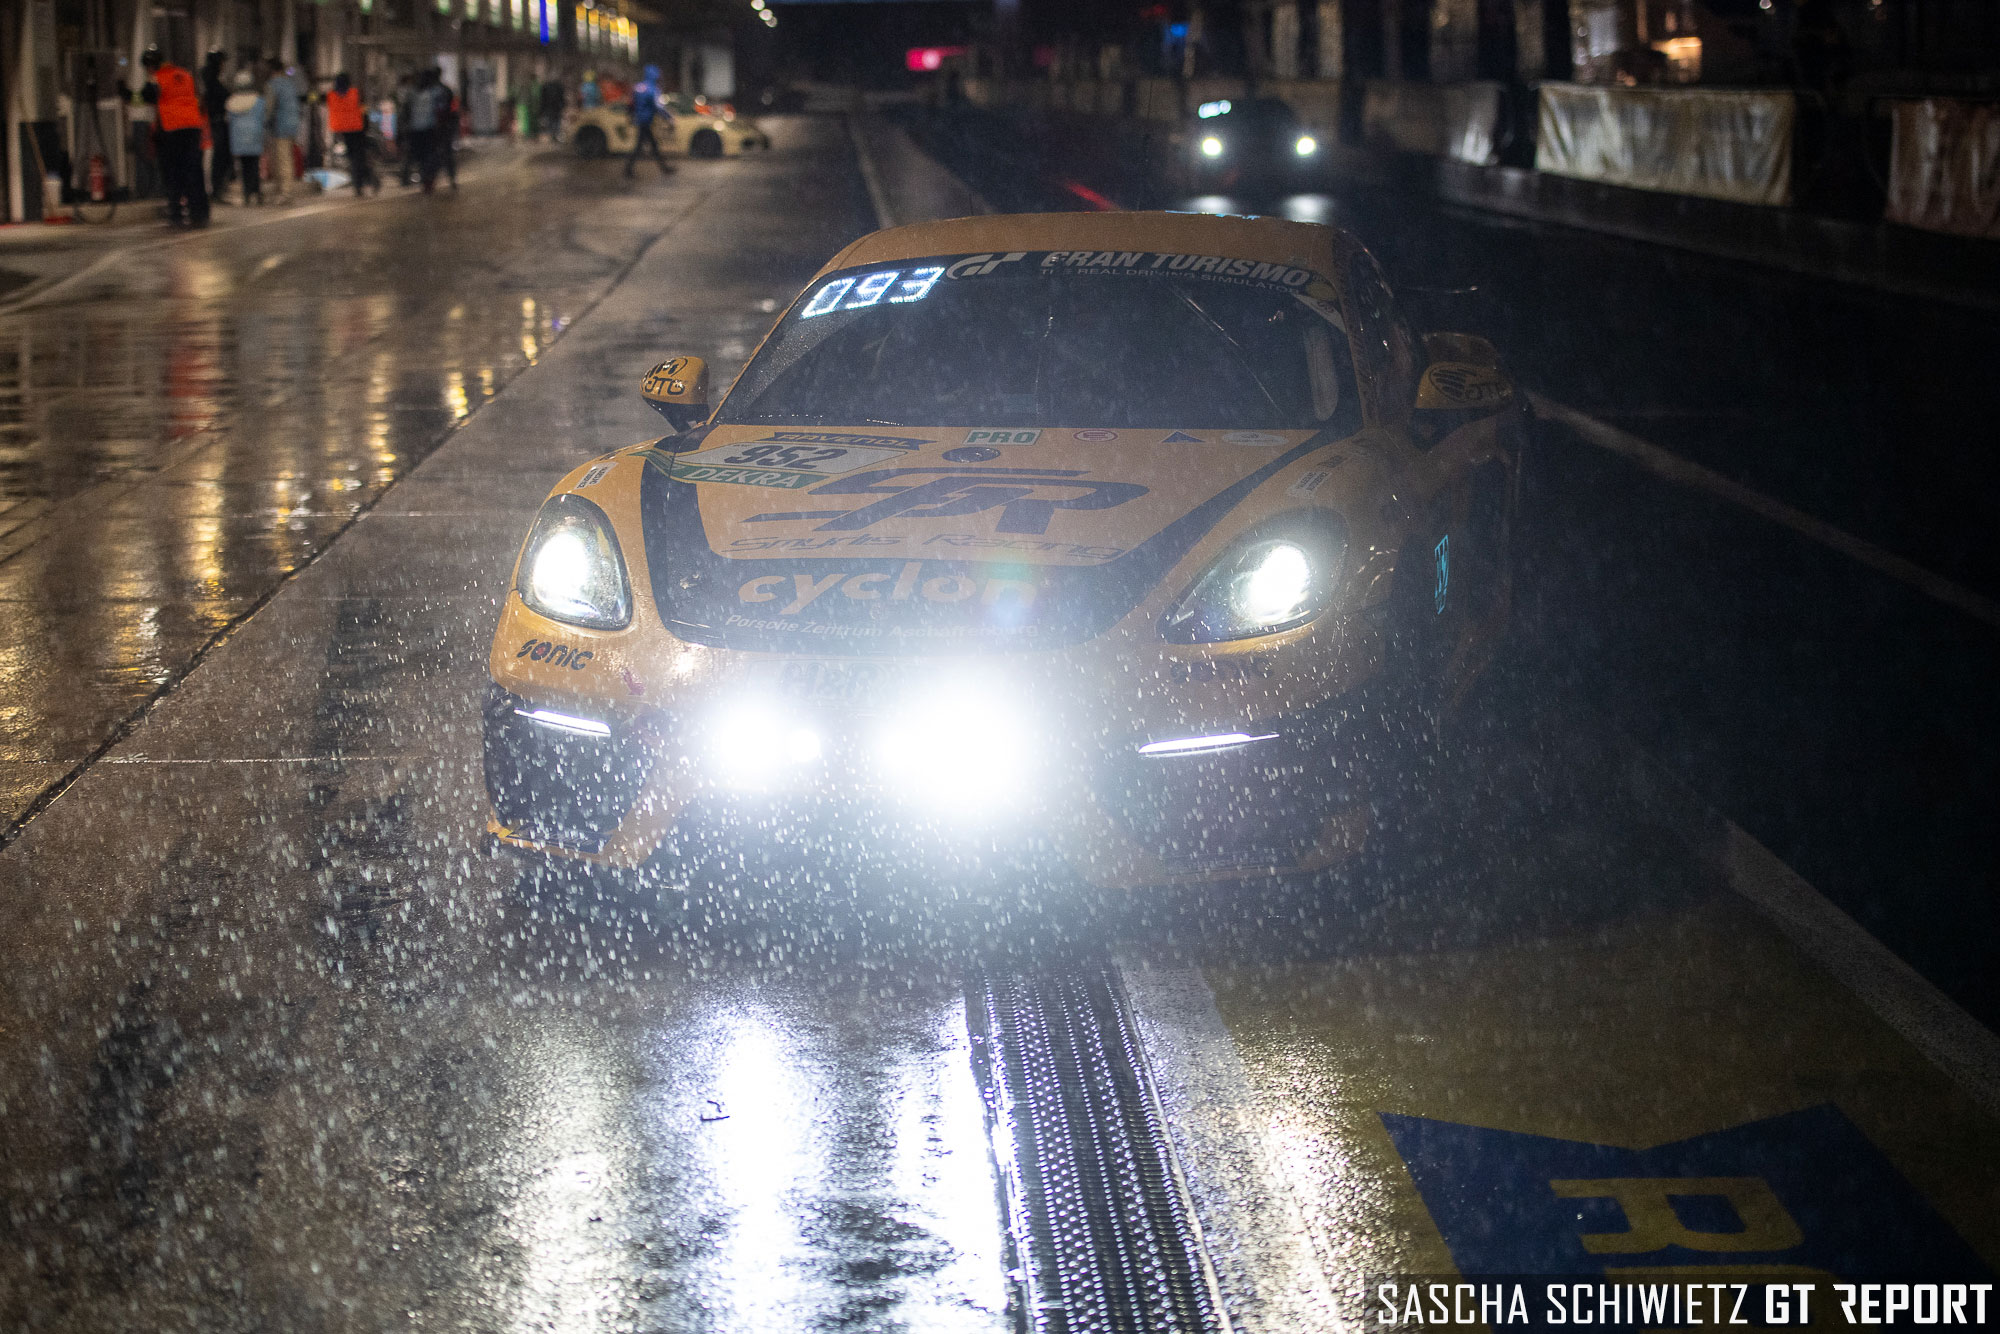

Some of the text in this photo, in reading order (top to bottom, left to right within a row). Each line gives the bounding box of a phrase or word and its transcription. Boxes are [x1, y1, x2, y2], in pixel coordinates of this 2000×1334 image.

[1041, 251, 1310, 287] GRAN TURISMO
[1077, 268, 1121, 276] REAL
[1200, 274, 1301, 294] SIMULATOR
[800, 266, 946, 319] 093
[776, 433, 912, 448] RAVENOL
[969, 430, 1035, 445] PRO
[724, 444, 848, 470] 952
[685, 467, 801, 488] DEKRA
[738, 562, 1038, 614] cyclon
[726, 614, 799, 632] Porsche
[800, 619, 882, 637] Zentrum
